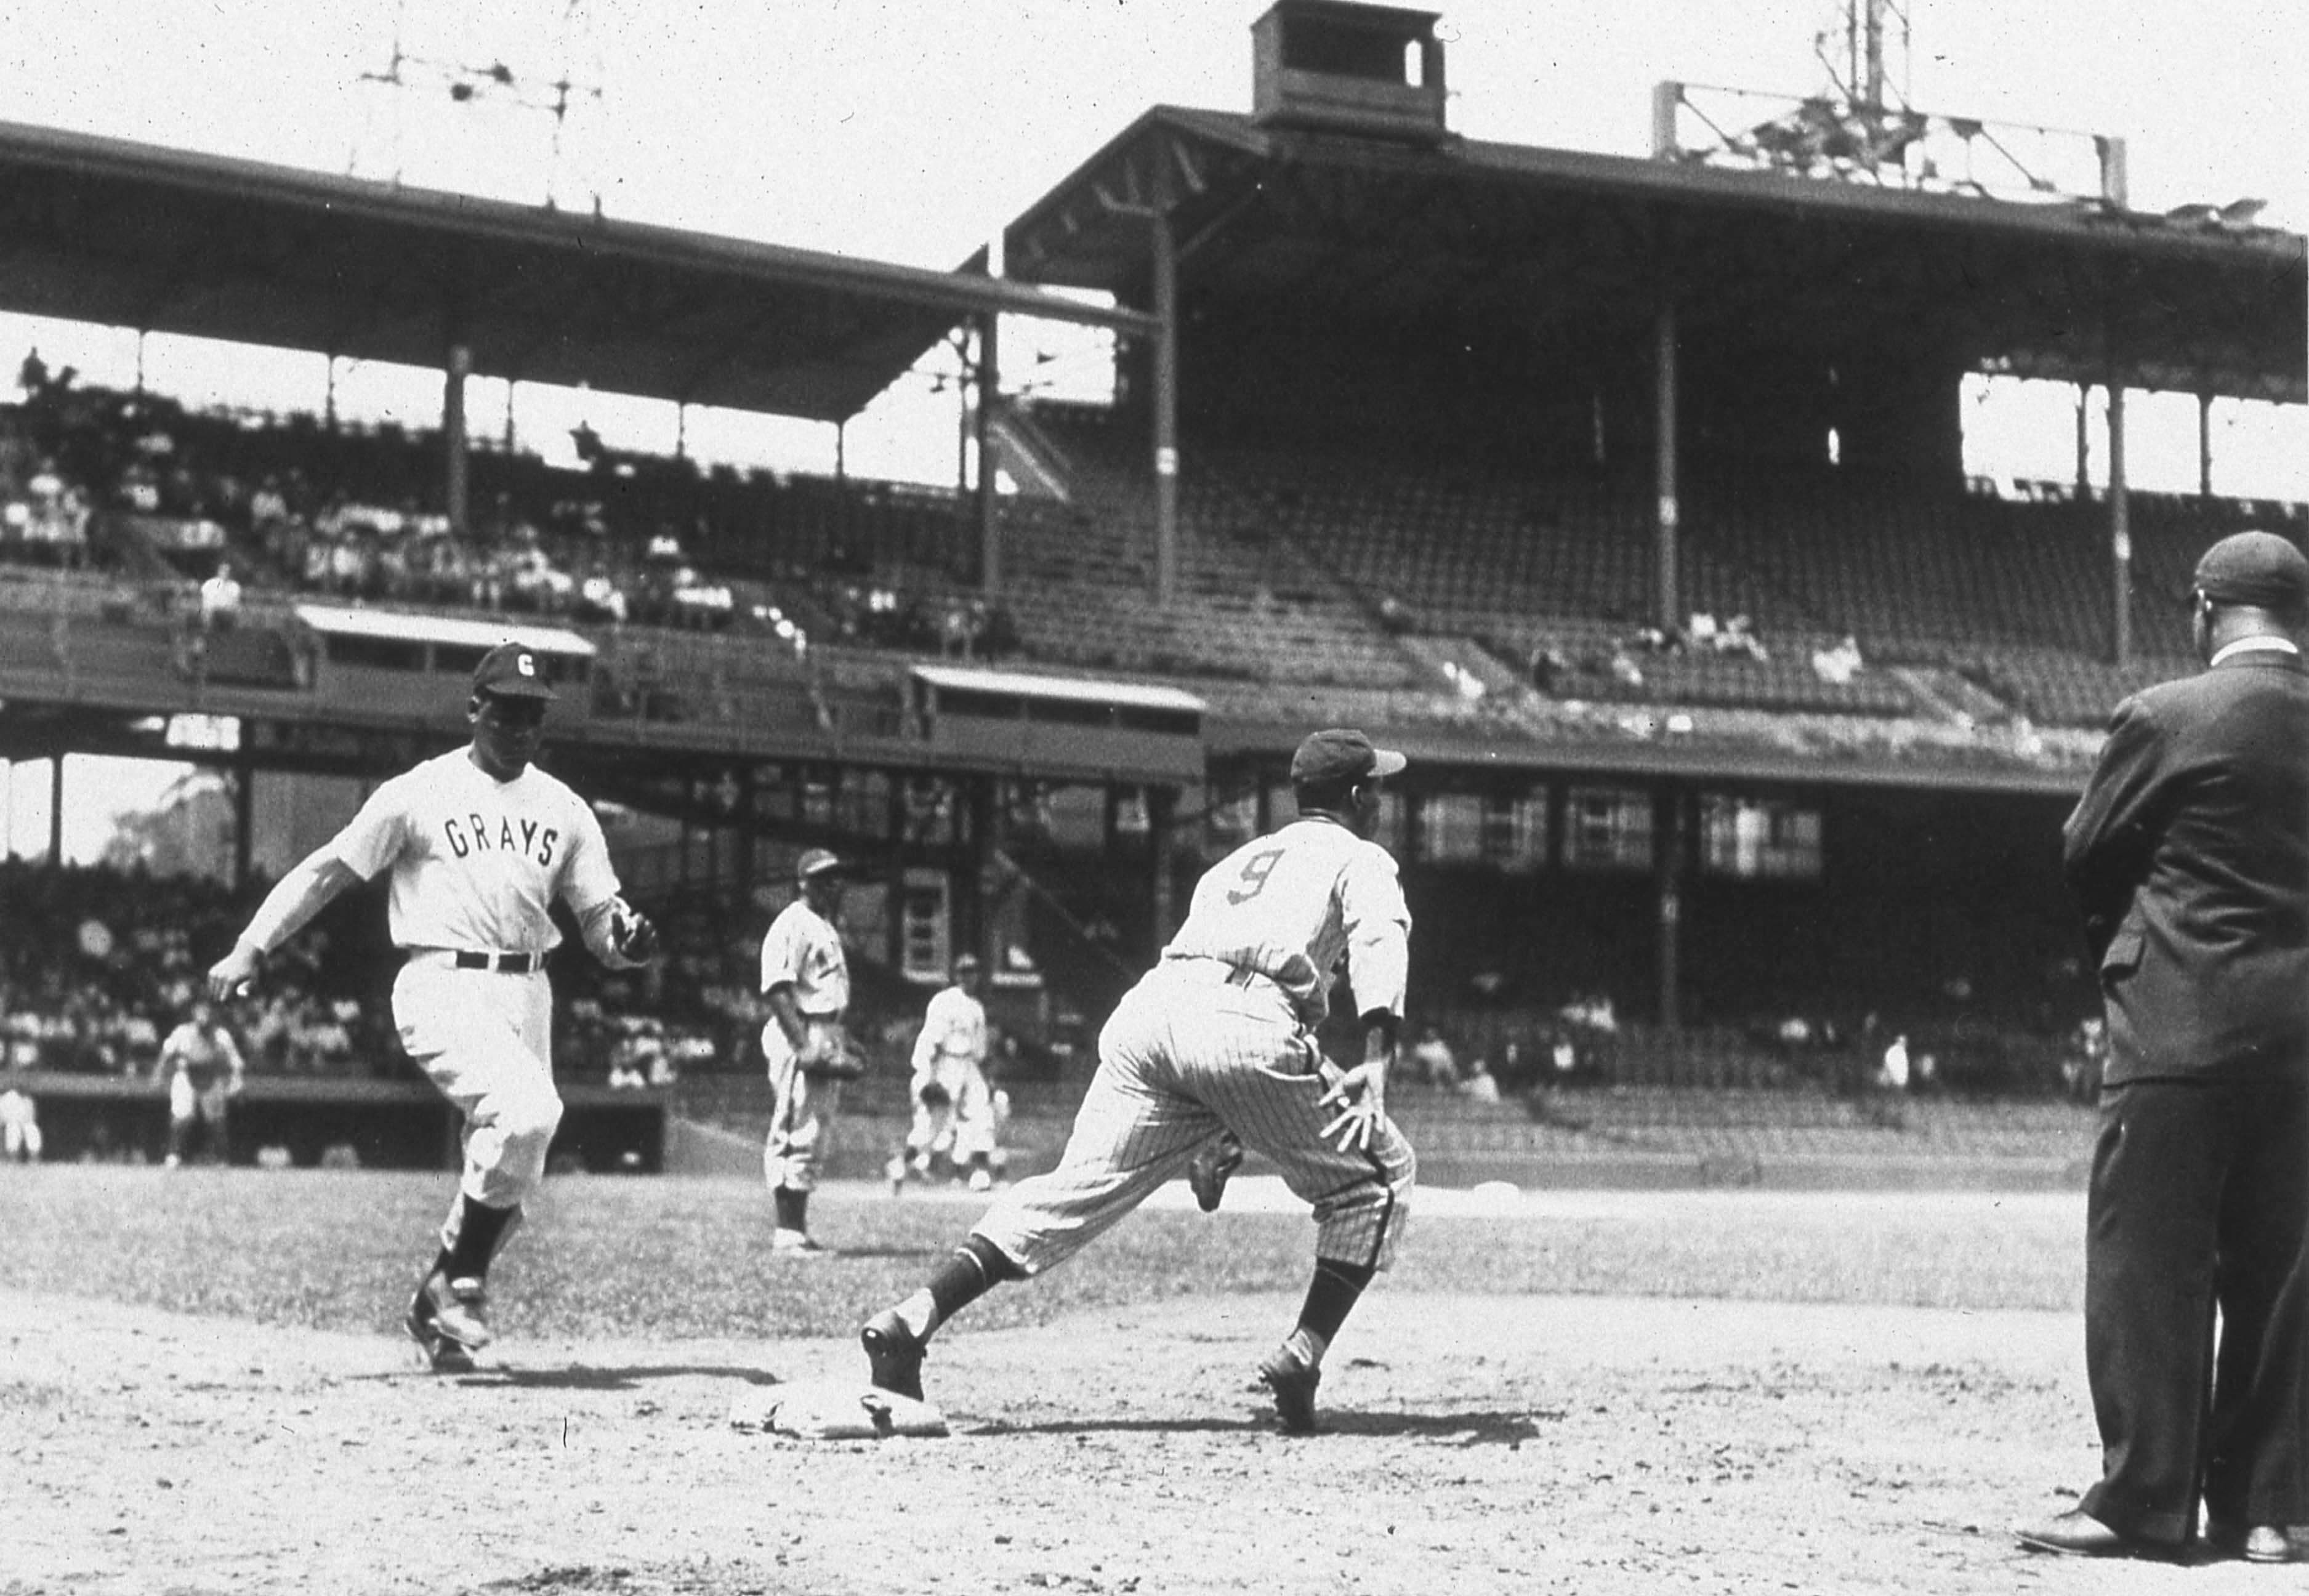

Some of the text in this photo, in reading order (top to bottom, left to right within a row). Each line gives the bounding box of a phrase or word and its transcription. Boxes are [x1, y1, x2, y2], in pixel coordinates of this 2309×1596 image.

[517, 653, 534, 676] G
[445, 813, 558, 867] GRAYS
[1226, 847, 1286, 906] 9
